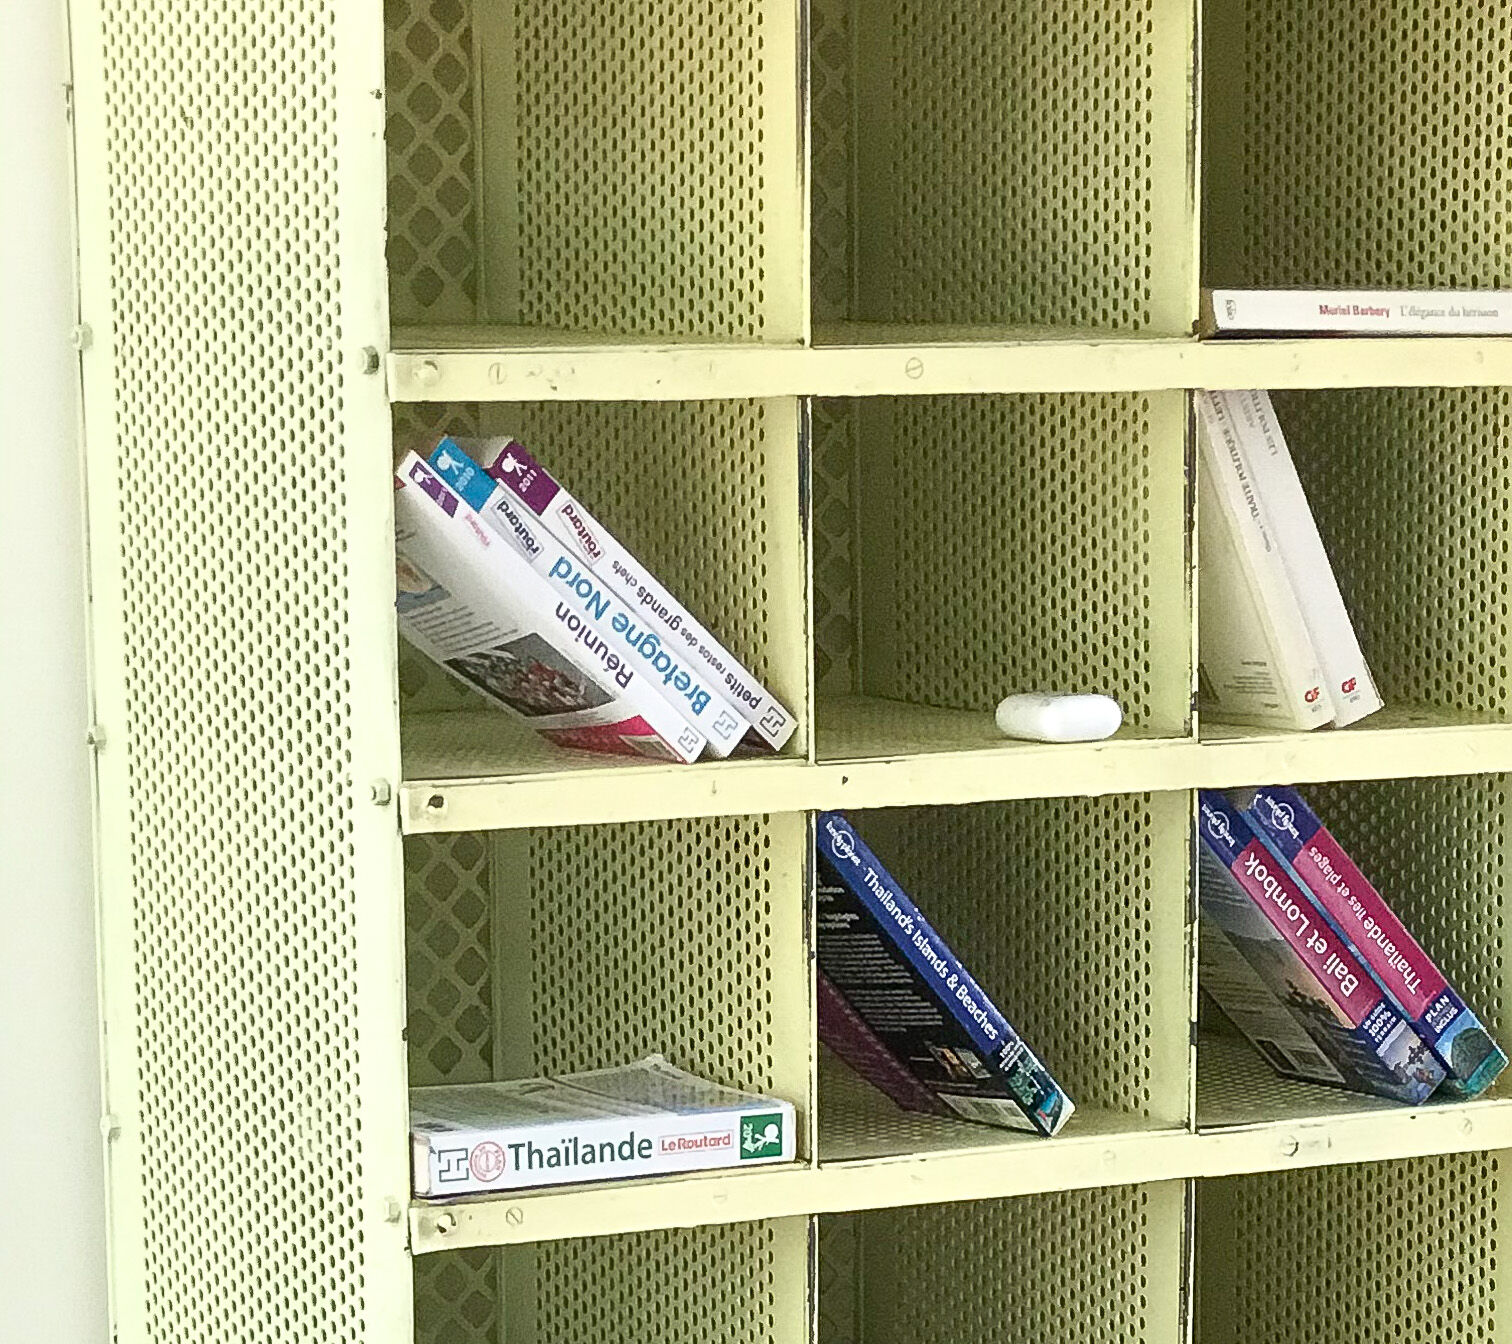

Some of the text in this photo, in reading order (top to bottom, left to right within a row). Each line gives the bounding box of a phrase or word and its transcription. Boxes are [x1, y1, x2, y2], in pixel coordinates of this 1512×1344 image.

[497, 501, 540, 554] routard
[560, 503, 605, 562] routard
[548, 555, 712, 718] Bretagne Nord
[555, 601, 635, 689] Réunion
[611, 559, 762, 711] petits restos des grands chefs
[1308, 846, 1344, 885] plages
[1336, 881, 1351, 897] et
[862, 868, 999, 1041] Thailand's Islands & Beaches
[1244, 851, 1359, 998] Bali et Lombok
[1363, 918, 1423, 996] Thaïlande
[1425, 995, 1450, 1023] PLAN
[508, 1131, 653, 1171] Thaïlande
